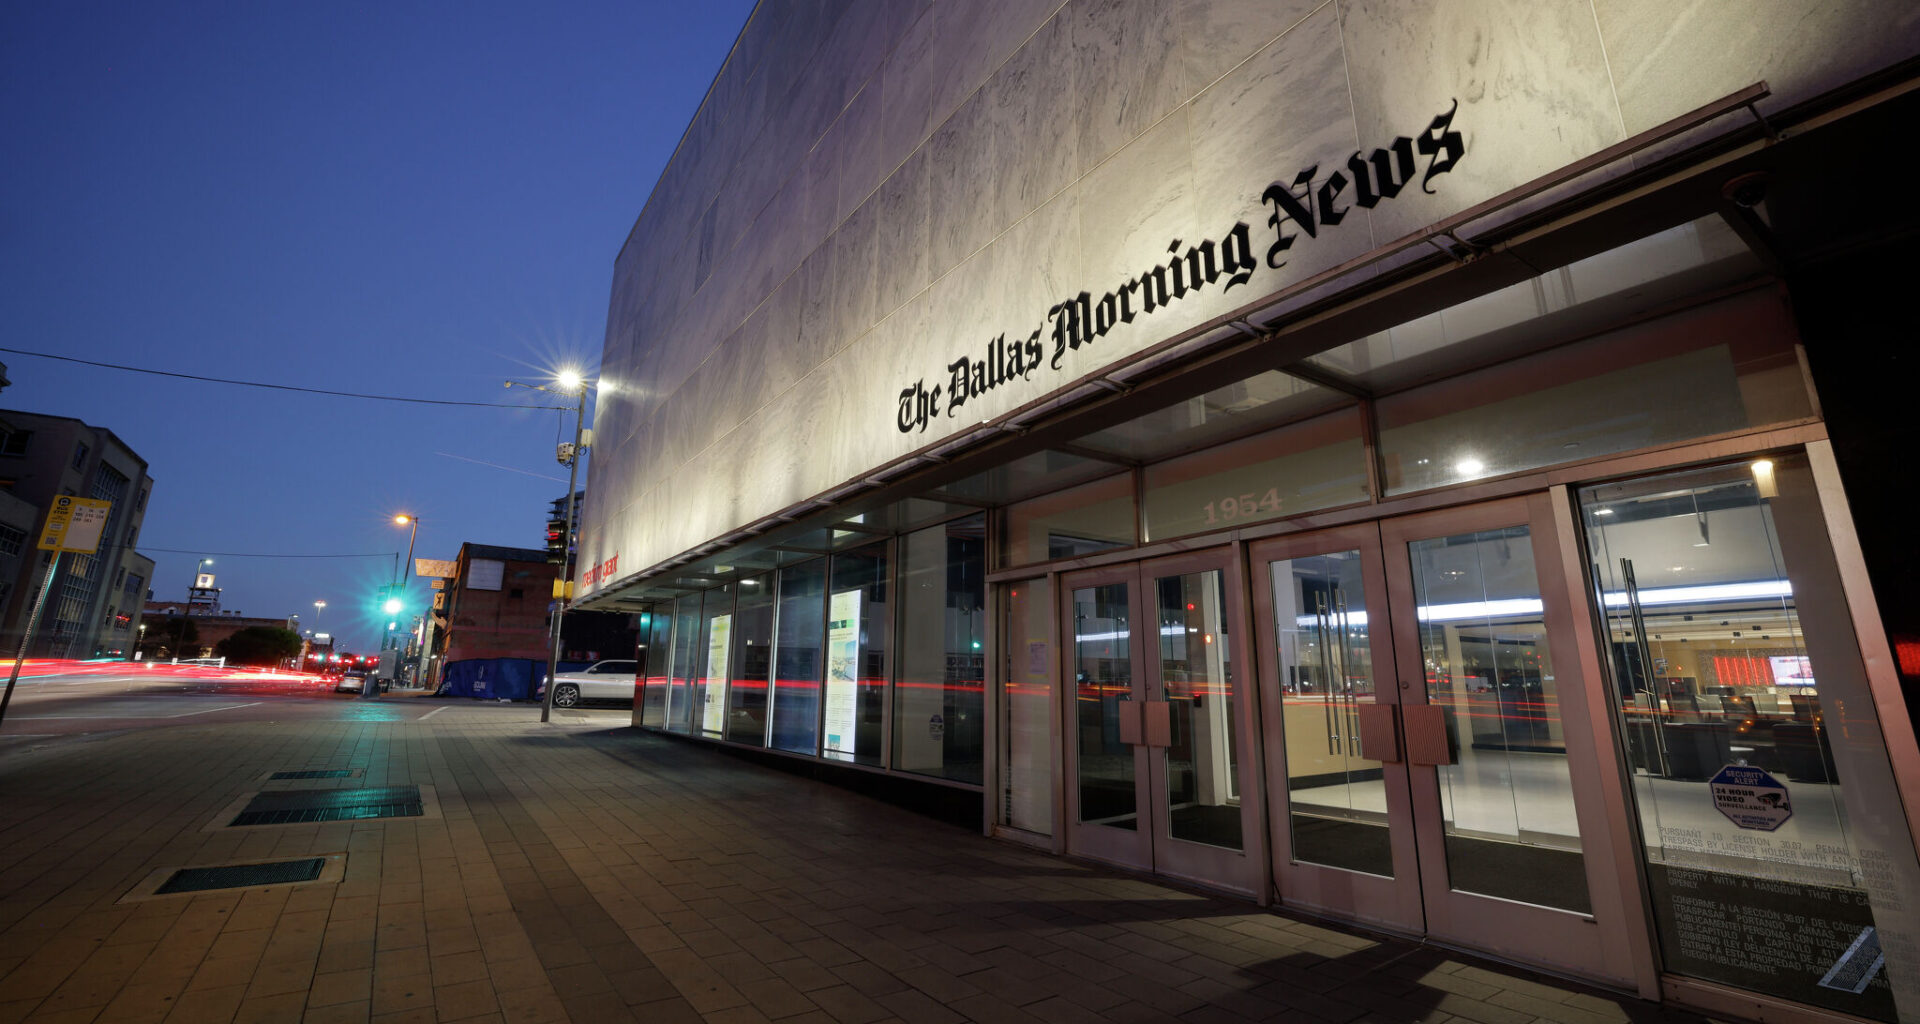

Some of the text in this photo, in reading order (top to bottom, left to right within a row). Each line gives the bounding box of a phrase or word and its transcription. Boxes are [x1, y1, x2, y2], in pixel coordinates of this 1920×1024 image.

[897, 98, 1467, 433] The Dallas Morning News
[1203, 488, 1284, 525] 1954
[602, 549, 619, 583] giant
[1725, 770, 1764, 780] SECURITY
[1734, 778, 1759, 786] ALERT
[1716, 795, 1745, 803] VIDEO
[1728, 788, 1755, 797] HOUR
[1718, 802, 1767, 812] SURVEILLANCE
[1659, 826, 1702, 838] PURSUANT
[1712, 832, 1723, 841] TO
[1732, 834, 1771, 847] SECTION
[1707, 840, 1719, 849] BY
[1721, 842, 1757, 854] LICENSE
[1761, 847, 1797, 859] HOLDER
[1800, 849, 1827, 862] WITH
[1712, 876, 1737, 887] WITH
[1741, 880, 1749, 889] A
[1753, 881, 1801, 896] HANDGUN
[1807, 889, 1832, 901] THAT
[1839, 894, 1849, 904] IS
[1671, 894, 1717, 909] CONFORME
[1719, 903, 1727, 911] A
[1728, 903, 1740, 913] LA
[1742, 906, 1781, 920] SECCIÓN
[1810, 917, 1831, 929] DEL
[1736, 914, 1786, 931] PORTANDO
[1798, 924, 1836, 940] ARMAS
[1743, 924, 1791, 941] PERSONAS
[1793, 933, 1814, 945] CON
[1678, 930, 1720, 946] GOBIERNO
[1800, 953, 1814, 964] DE
[1680, 938, 1713, 953] ENTRAR
[1715, 946, 1722, 954] A
[1725, 947, 1747, 960] ESTA
[1750, 953, 1802, 972] PROPIEDAD
